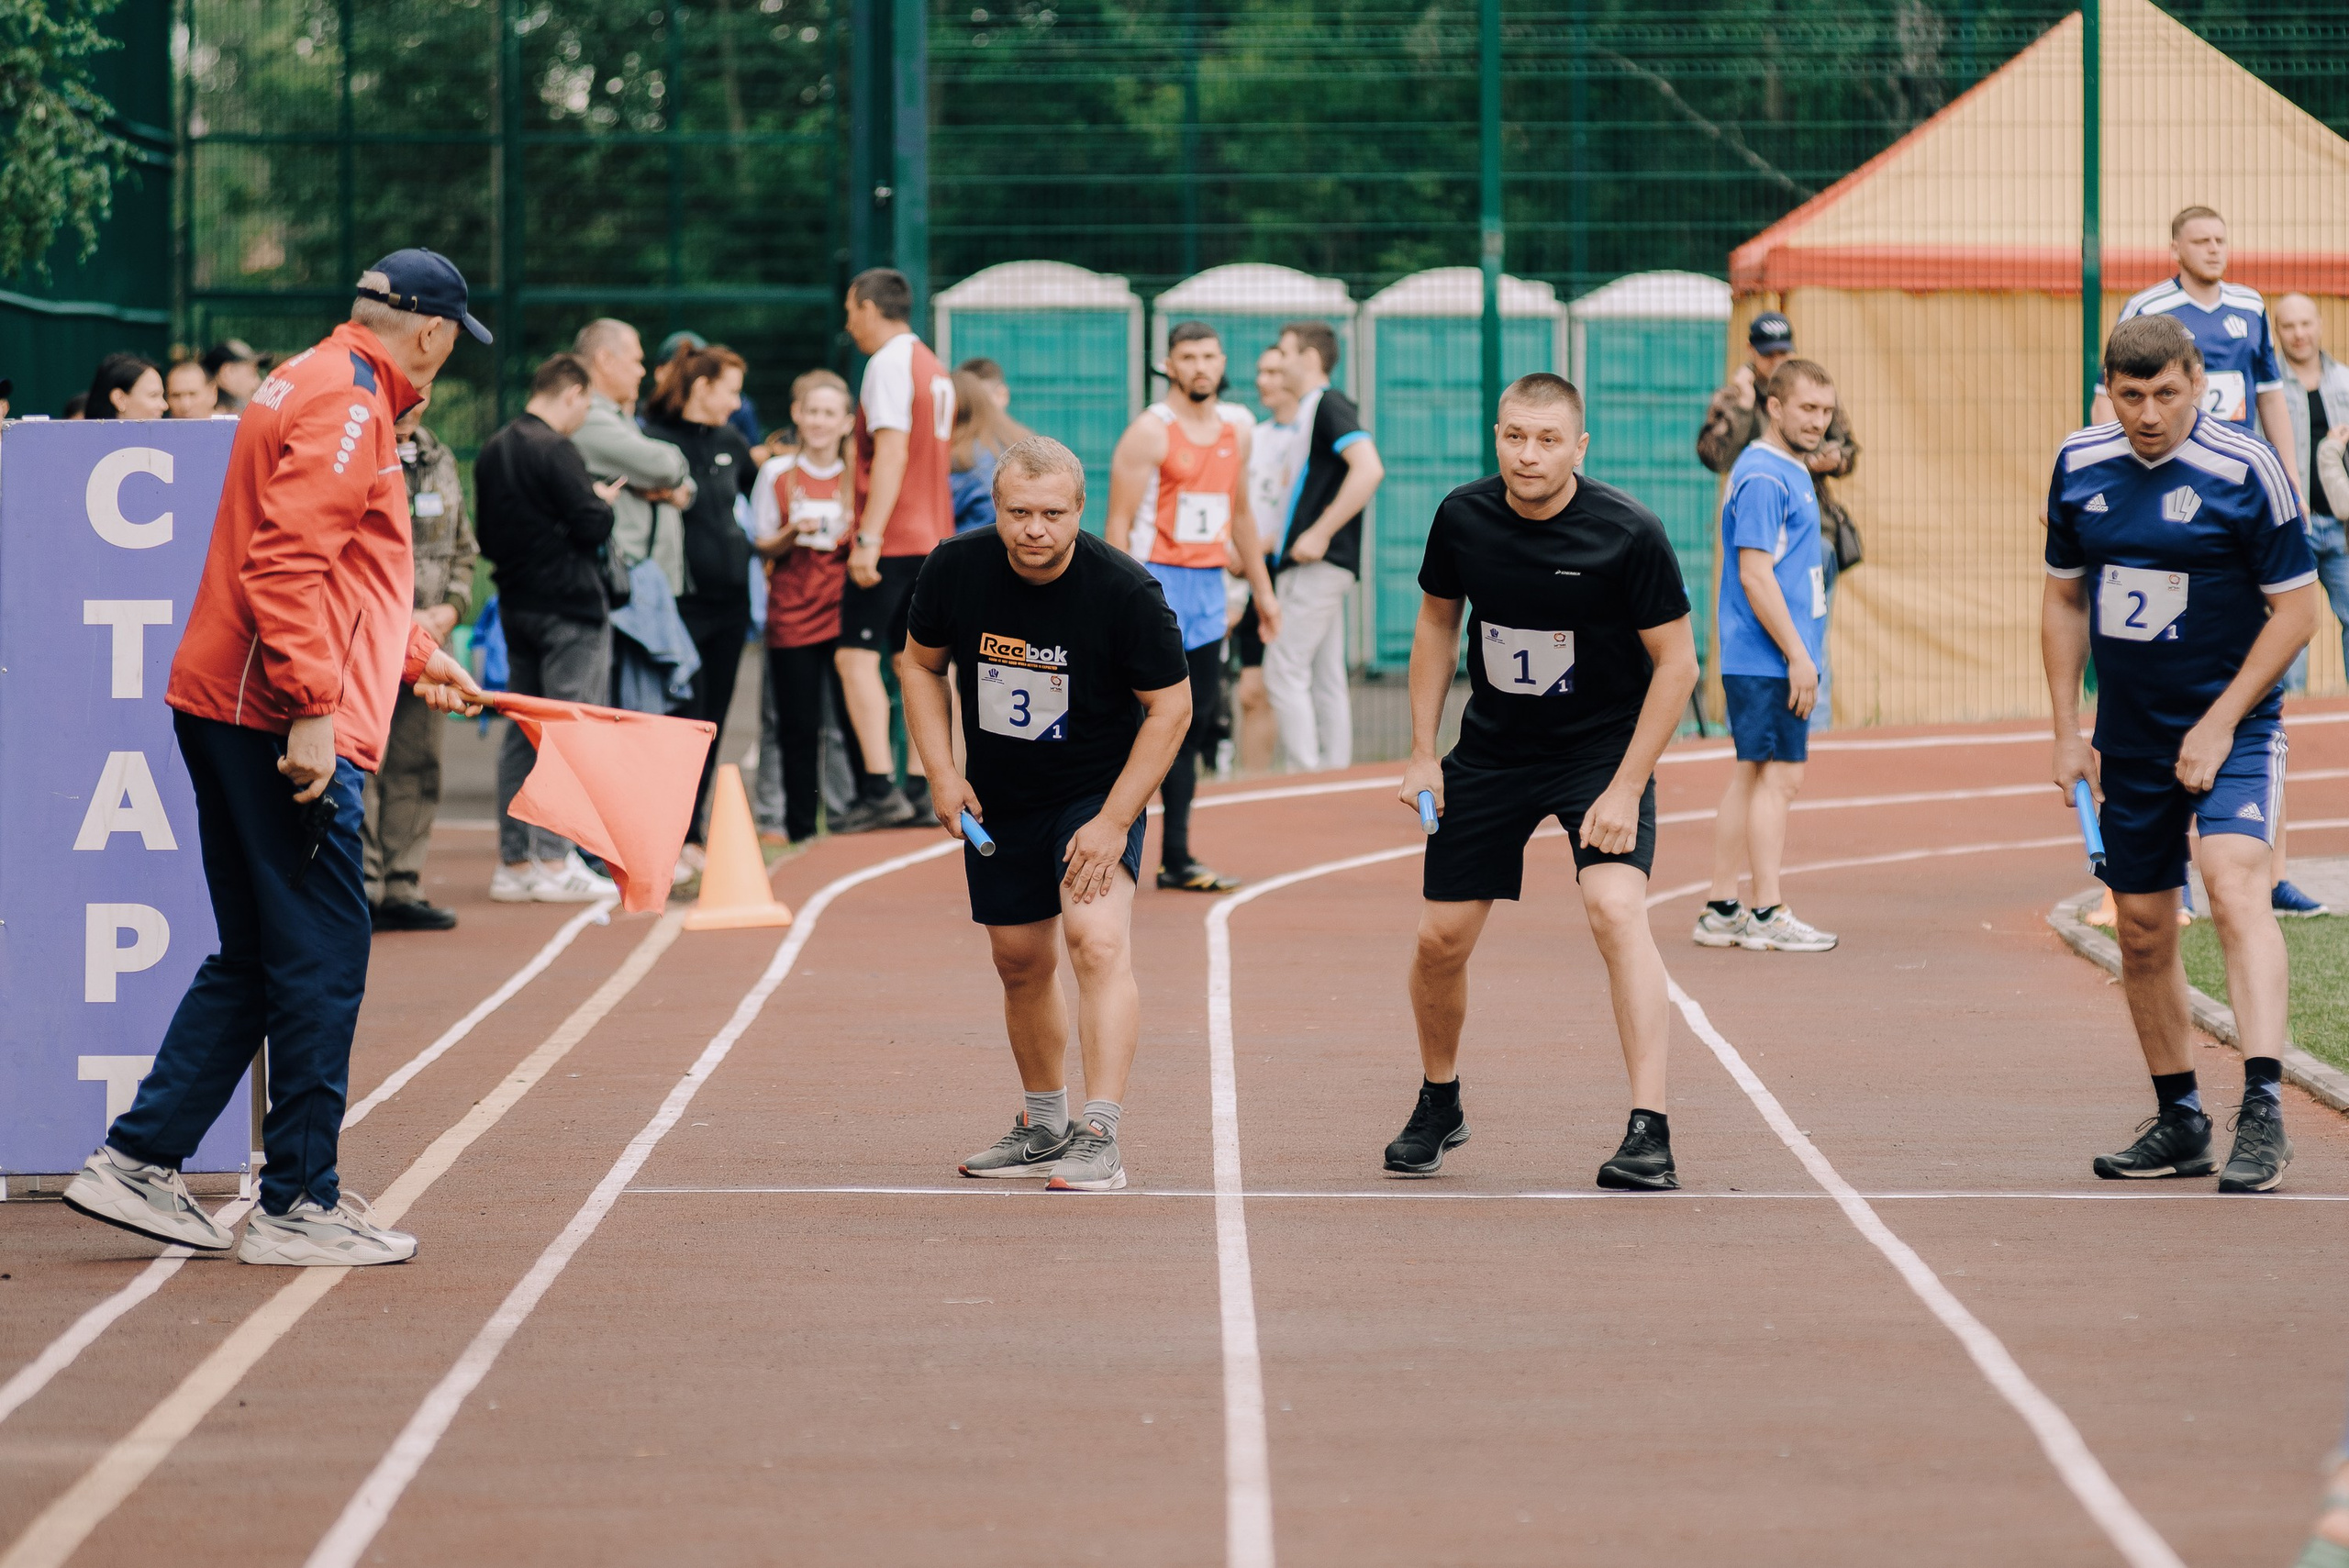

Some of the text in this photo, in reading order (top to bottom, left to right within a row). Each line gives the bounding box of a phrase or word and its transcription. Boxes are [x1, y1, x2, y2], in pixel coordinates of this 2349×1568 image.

[2210, 388, 2226, 414] 2
[1197, 508, 1208, 533] 1
[2125, 590, 2148, 629] 2
[2169, 624, 2179, 639] 1
[983, 636, 1068, 663] Reebok
[1513, 650, 1536, 685] 1
[1558, 679, 1568, 693] 1
[1009, 689, 1030, 728] 3
[1052, 724, 1062, 739] 1
[72, 447, 178, 1136] СТАРТ
[2239, 812, 2265, 822] adidas
